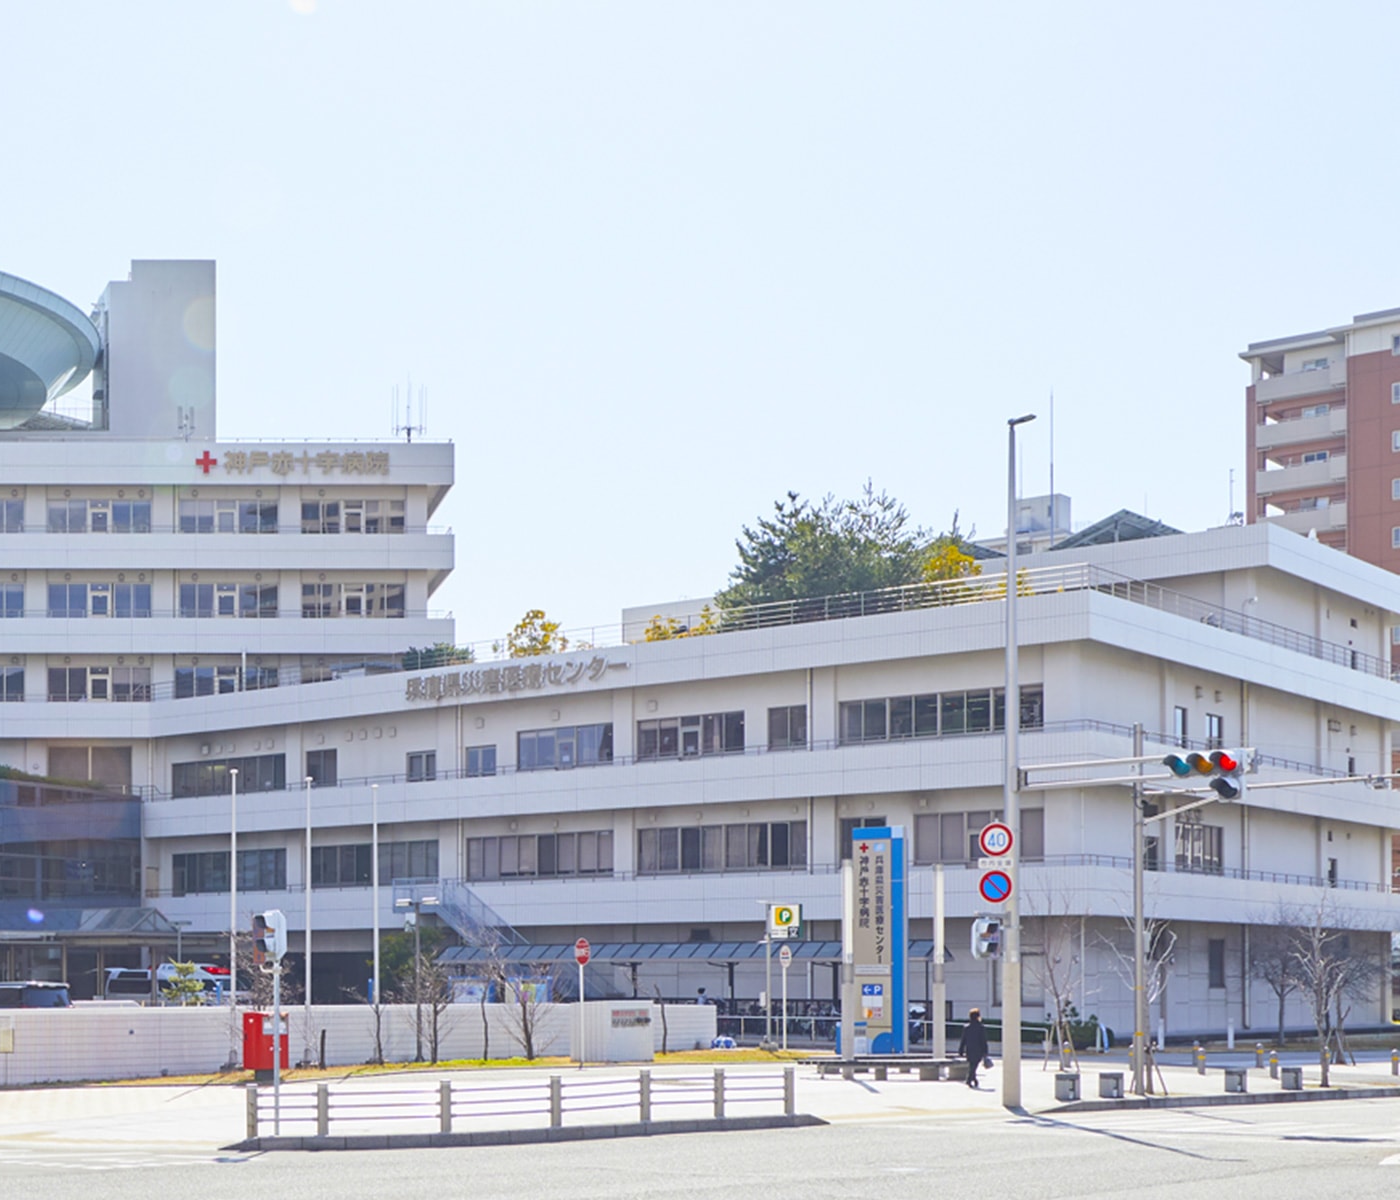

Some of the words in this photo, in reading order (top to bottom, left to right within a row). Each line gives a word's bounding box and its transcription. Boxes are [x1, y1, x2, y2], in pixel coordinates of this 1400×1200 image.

[223, 450, 390, 476] 神戸赤十字病院
[406, 655, 632, 702] 兵庫県災害医療センター
[987, 832, 1006, 848] 40
[858, 855, 870, 929] 神戸赤十字病院
[875, 855, 885, 964] 兵庫県災害医療センター
[873, 985, 882, 995] P
